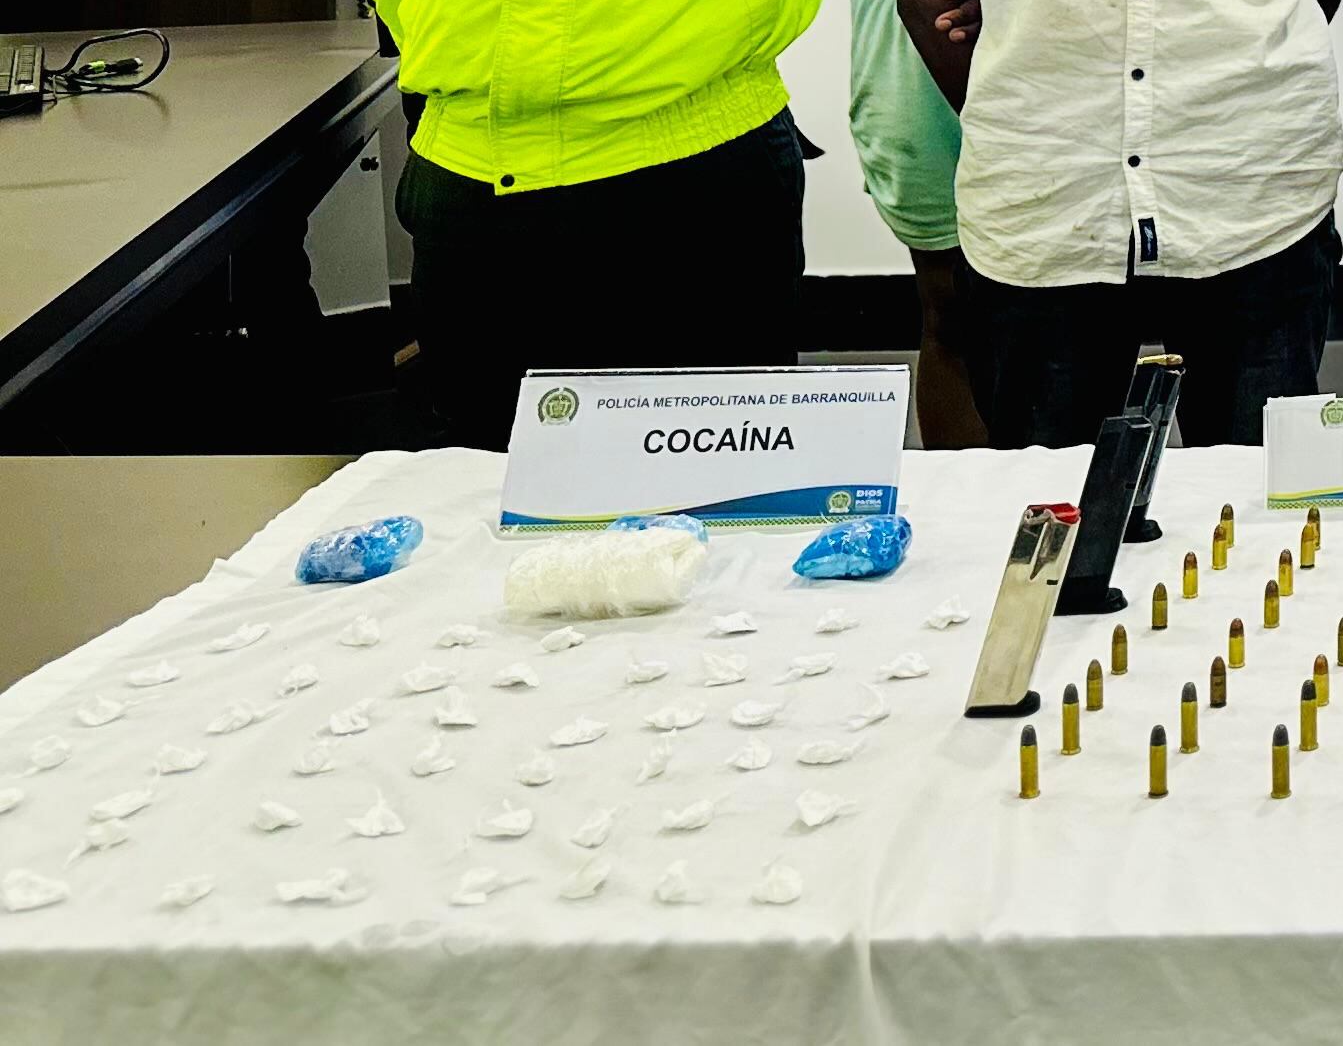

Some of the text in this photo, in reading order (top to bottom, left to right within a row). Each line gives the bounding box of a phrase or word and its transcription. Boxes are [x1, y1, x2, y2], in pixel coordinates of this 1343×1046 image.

[653, 394, 765, 408] METROPOLITANA
[769, 394, 787, 406] DE
[792, 391, 896, 405] BARRANQUILLA
[643, 421, 795, 454] COCAÍNA
